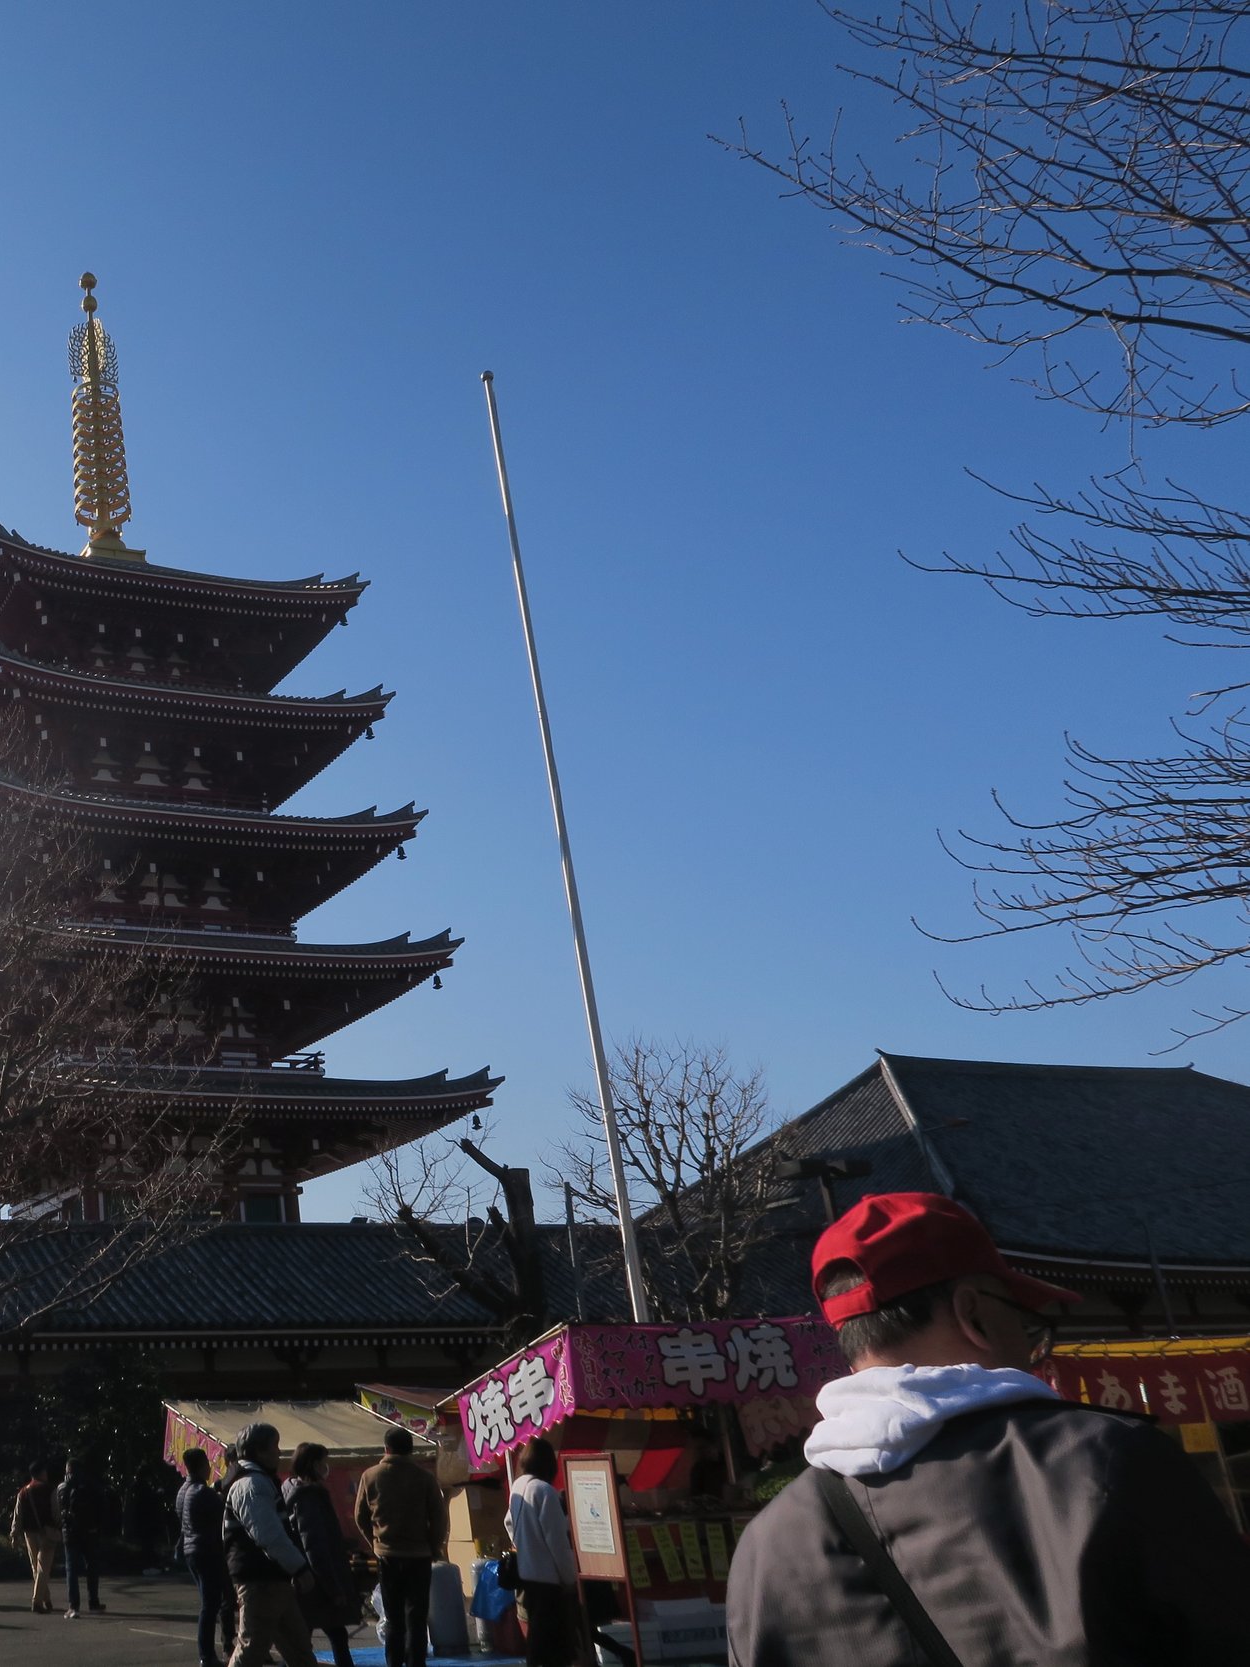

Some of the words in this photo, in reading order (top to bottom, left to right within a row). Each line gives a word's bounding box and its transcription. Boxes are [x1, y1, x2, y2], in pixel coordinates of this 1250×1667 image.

[656, 1323, 798, 1397] 串焼
[1097, 1366, 1250, 1415] あま酒
